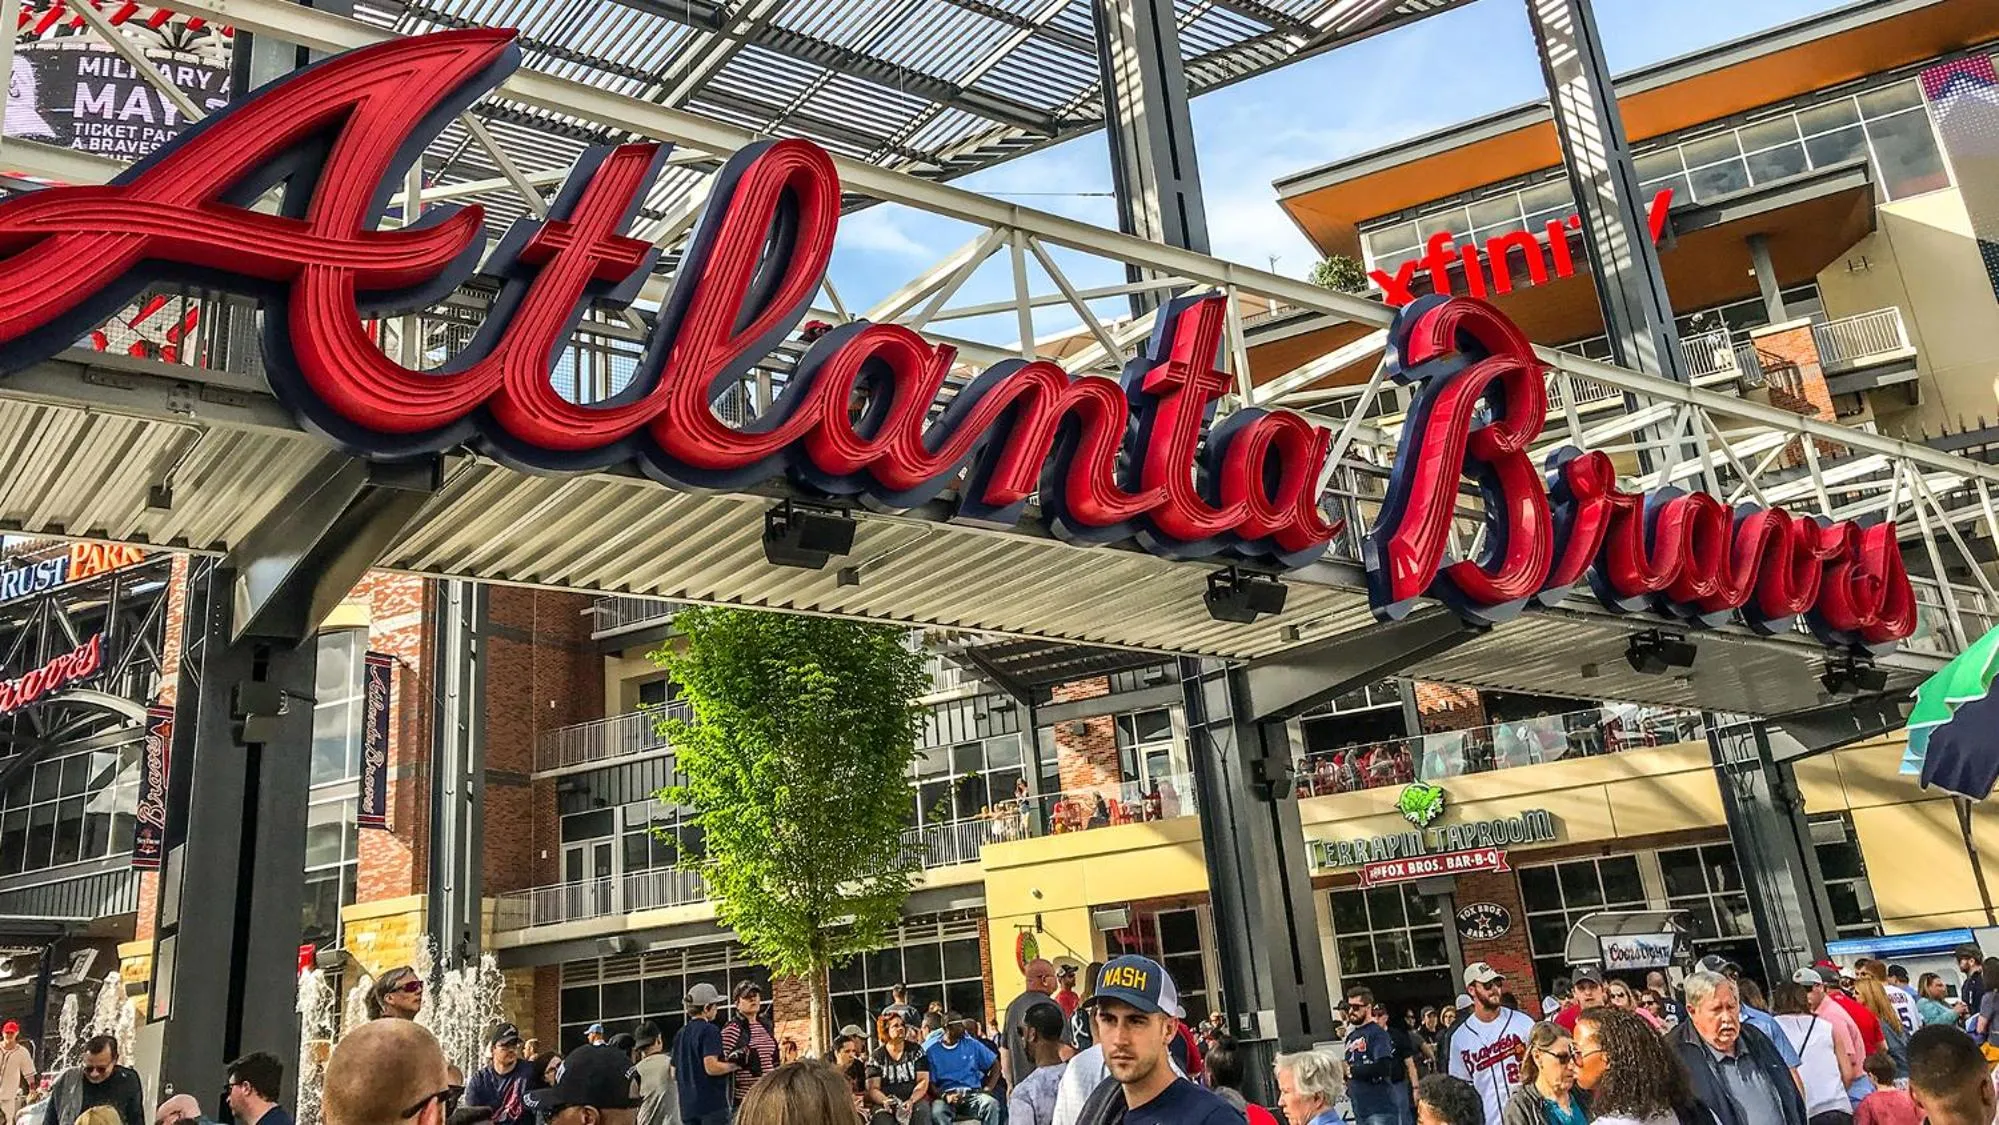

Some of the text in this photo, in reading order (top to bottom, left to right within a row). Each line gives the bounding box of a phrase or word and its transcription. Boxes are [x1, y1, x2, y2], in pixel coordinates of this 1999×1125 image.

[78, 56, 213, 90] MILIARY
[73, 82, 179, 126] MAY
[72, 121, 139, 139] TICKET
[89, 138, 161, 154] BRAVES
[1366, 188, 1674, 307] xfini
[0, 26, 1918, 650] Atlanta Braves
[0, 633, 101, 713] raves
[137, 735, 166, 830] Braves
[1305, 808, 1558, 870] TERRAPIN TAPROOM
[1381, 863, 1405, 878] FOX
[1407, 858, 1444, 875] BROS.
[1459, 906, 1478, 921] FOX
[1102, 966, 1148, 992] NASH
